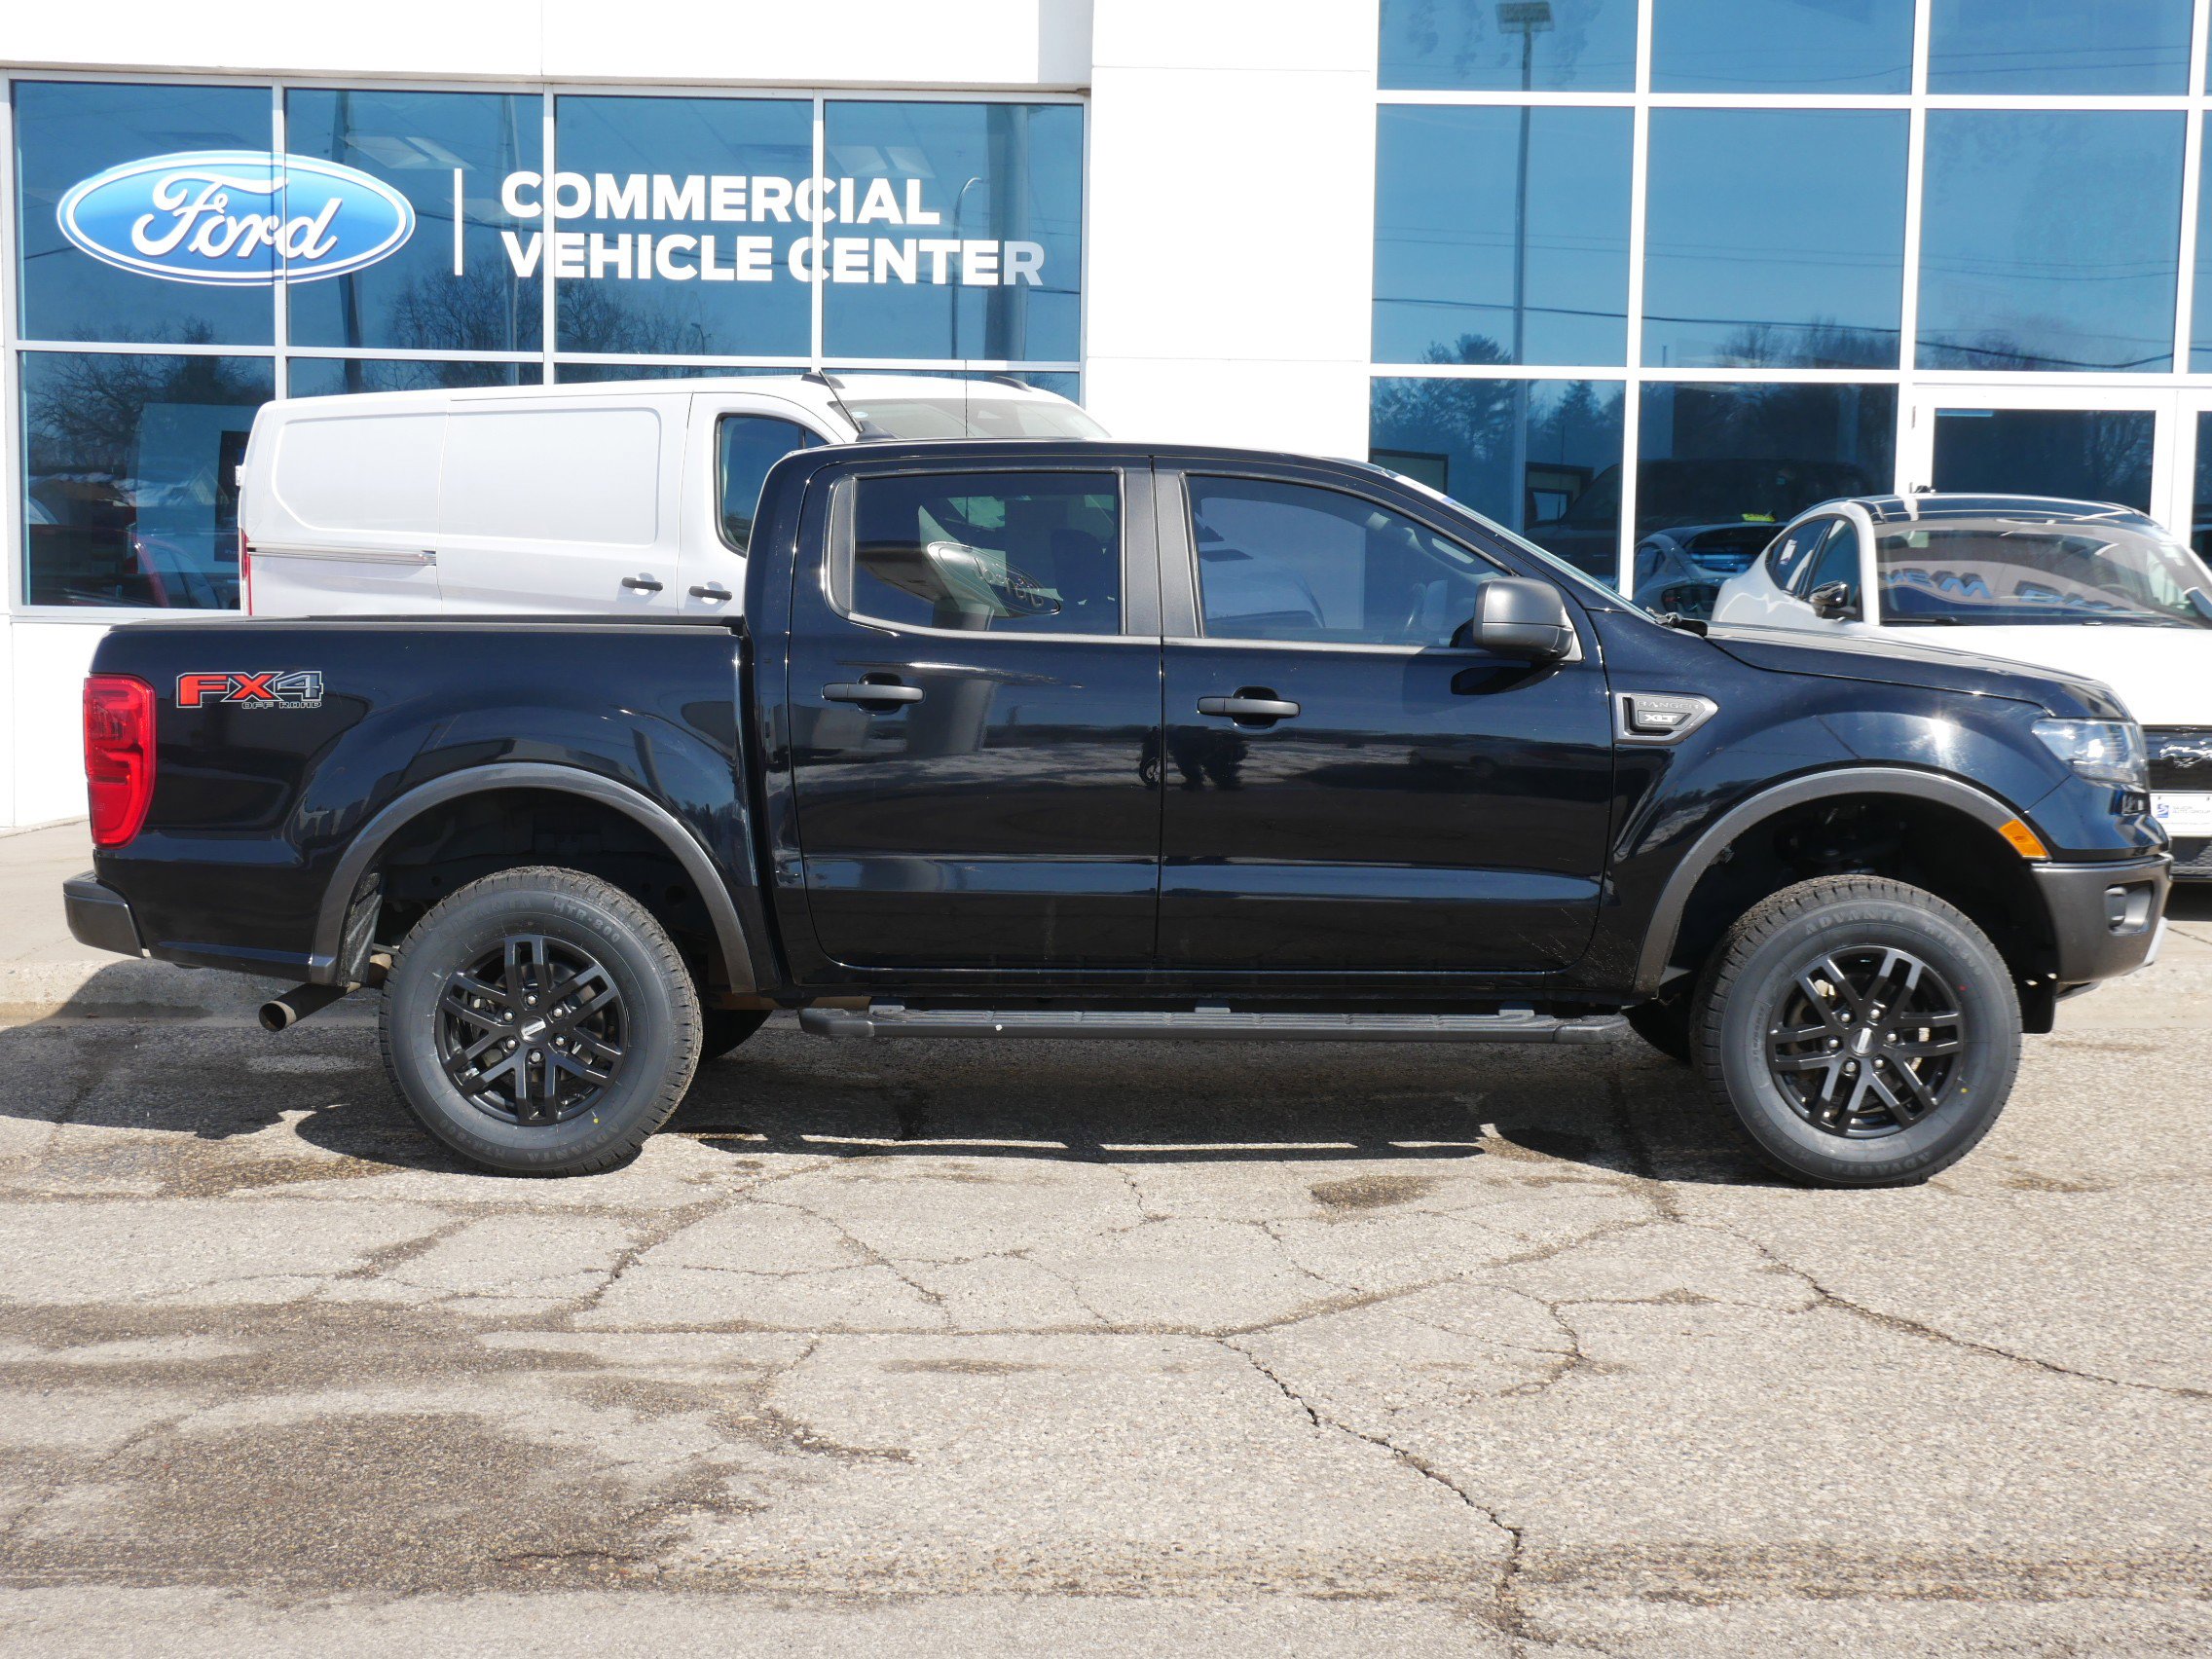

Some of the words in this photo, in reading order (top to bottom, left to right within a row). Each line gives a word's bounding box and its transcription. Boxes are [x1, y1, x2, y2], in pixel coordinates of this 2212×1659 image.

[131, 171, 343, 259] Ford
[501, 171, 940, 225] COMMERCIAL
[501, 232, 773, 280] VEHICLE
[788, 236, 1045, 286] CENTER
[176, 671, 323, 708] FX4
[1643, 714, 1677, 722] XLT
